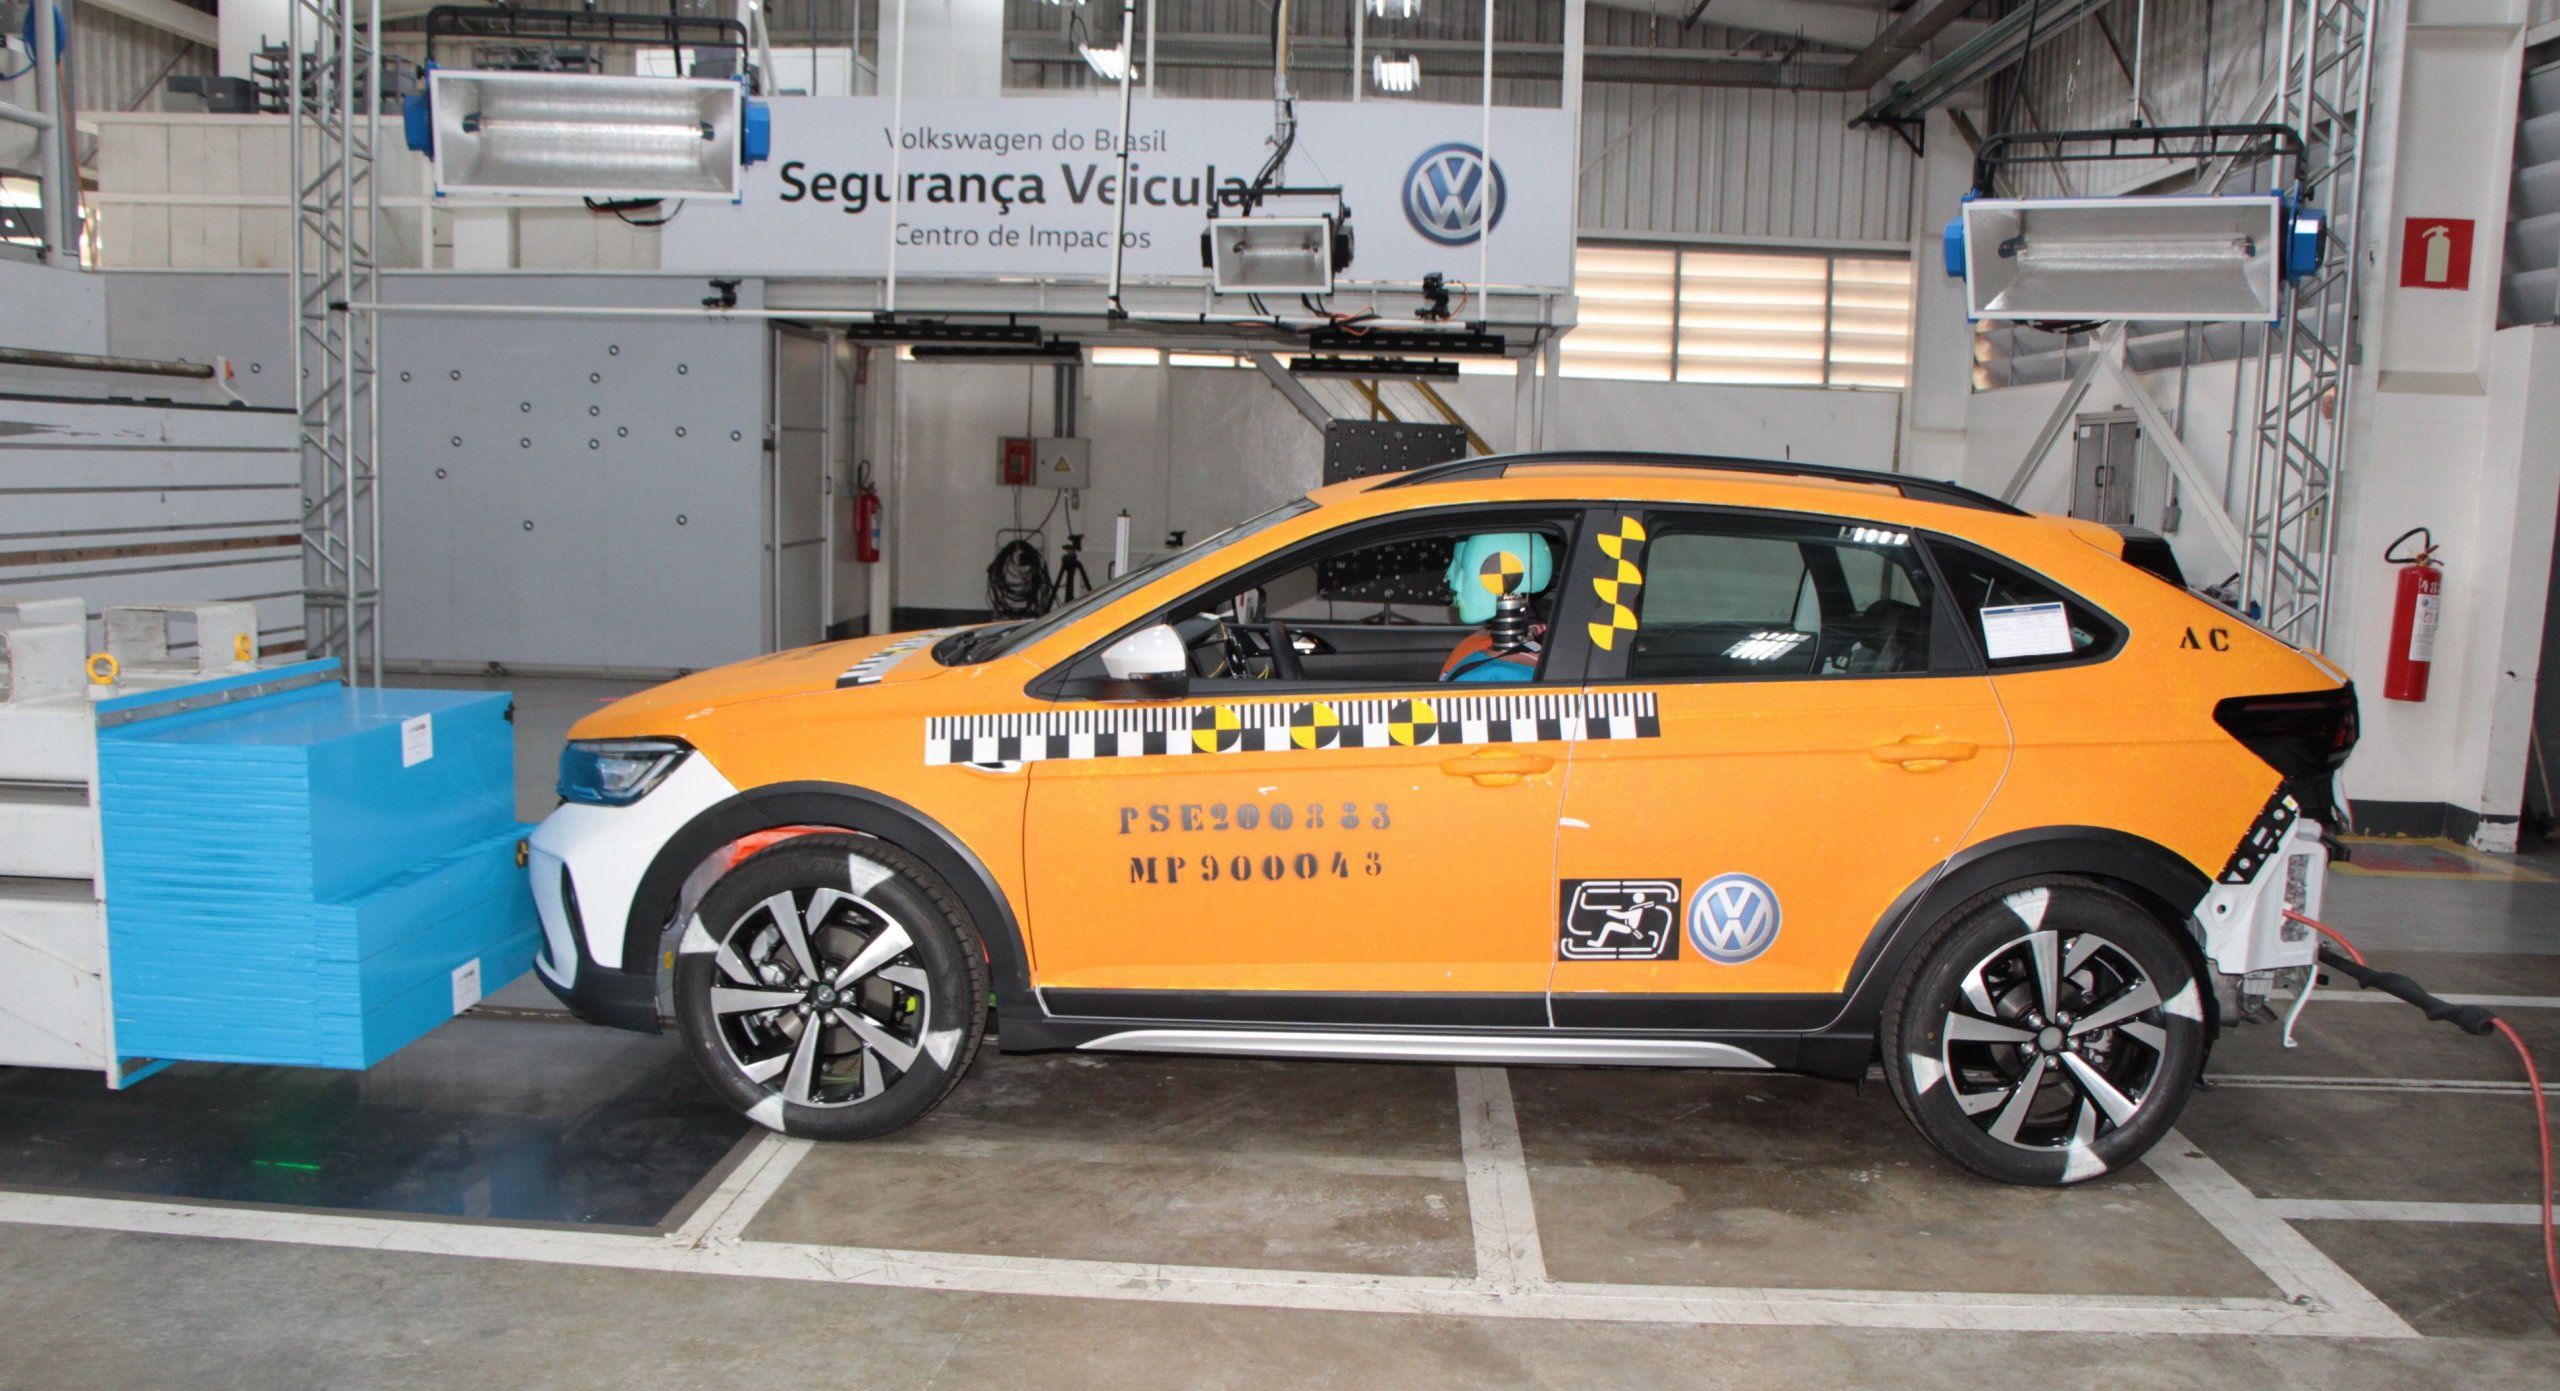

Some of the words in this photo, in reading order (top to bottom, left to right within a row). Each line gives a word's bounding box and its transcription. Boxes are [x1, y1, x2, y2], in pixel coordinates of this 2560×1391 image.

[1052, 128, 1084, 151] do
[780, 161, 1046, 215] Segurança
[1410, 150, 1498, 239] VW
[895, 223, 979, 246] Centro
[988, 225, 1020, 247] de
[1029, 224, 1151, 252] Impacos
[1693, 880, 1774, 958] VW
